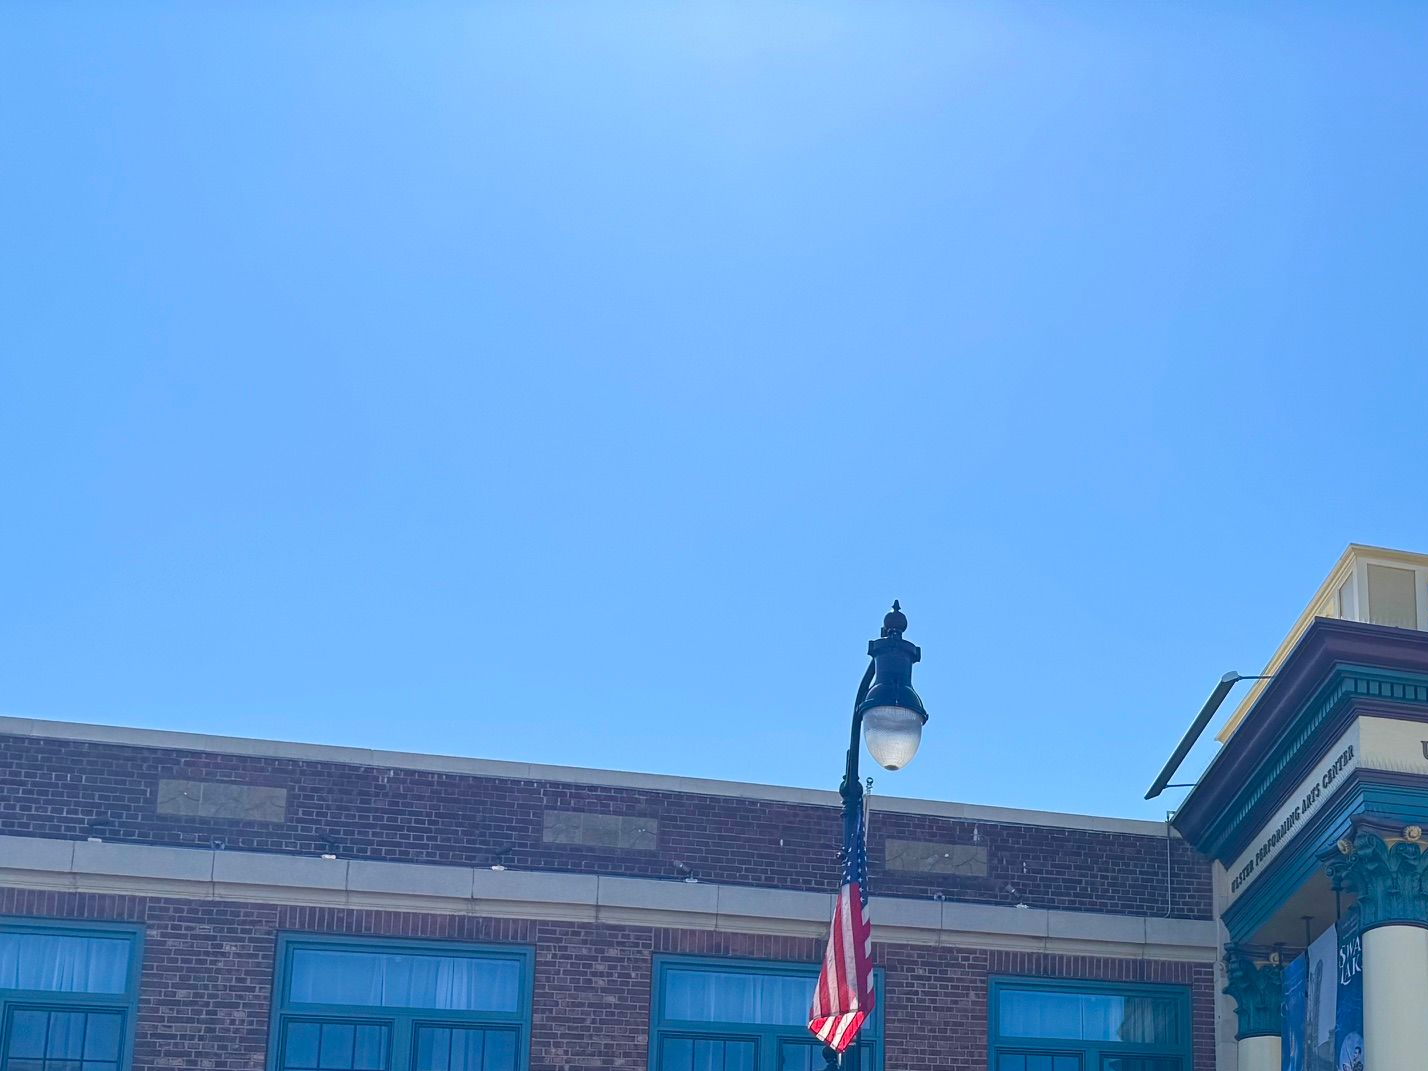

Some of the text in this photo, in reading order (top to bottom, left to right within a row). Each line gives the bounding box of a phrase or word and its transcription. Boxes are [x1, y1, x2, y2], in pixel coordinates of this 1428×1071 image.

[1231, 745, 1354, 893] ULSTER PERFORMING ARTS CENTER
[1339, 936, 1362, 968] SWA
[1340, 954, 1362, 986] LAK
